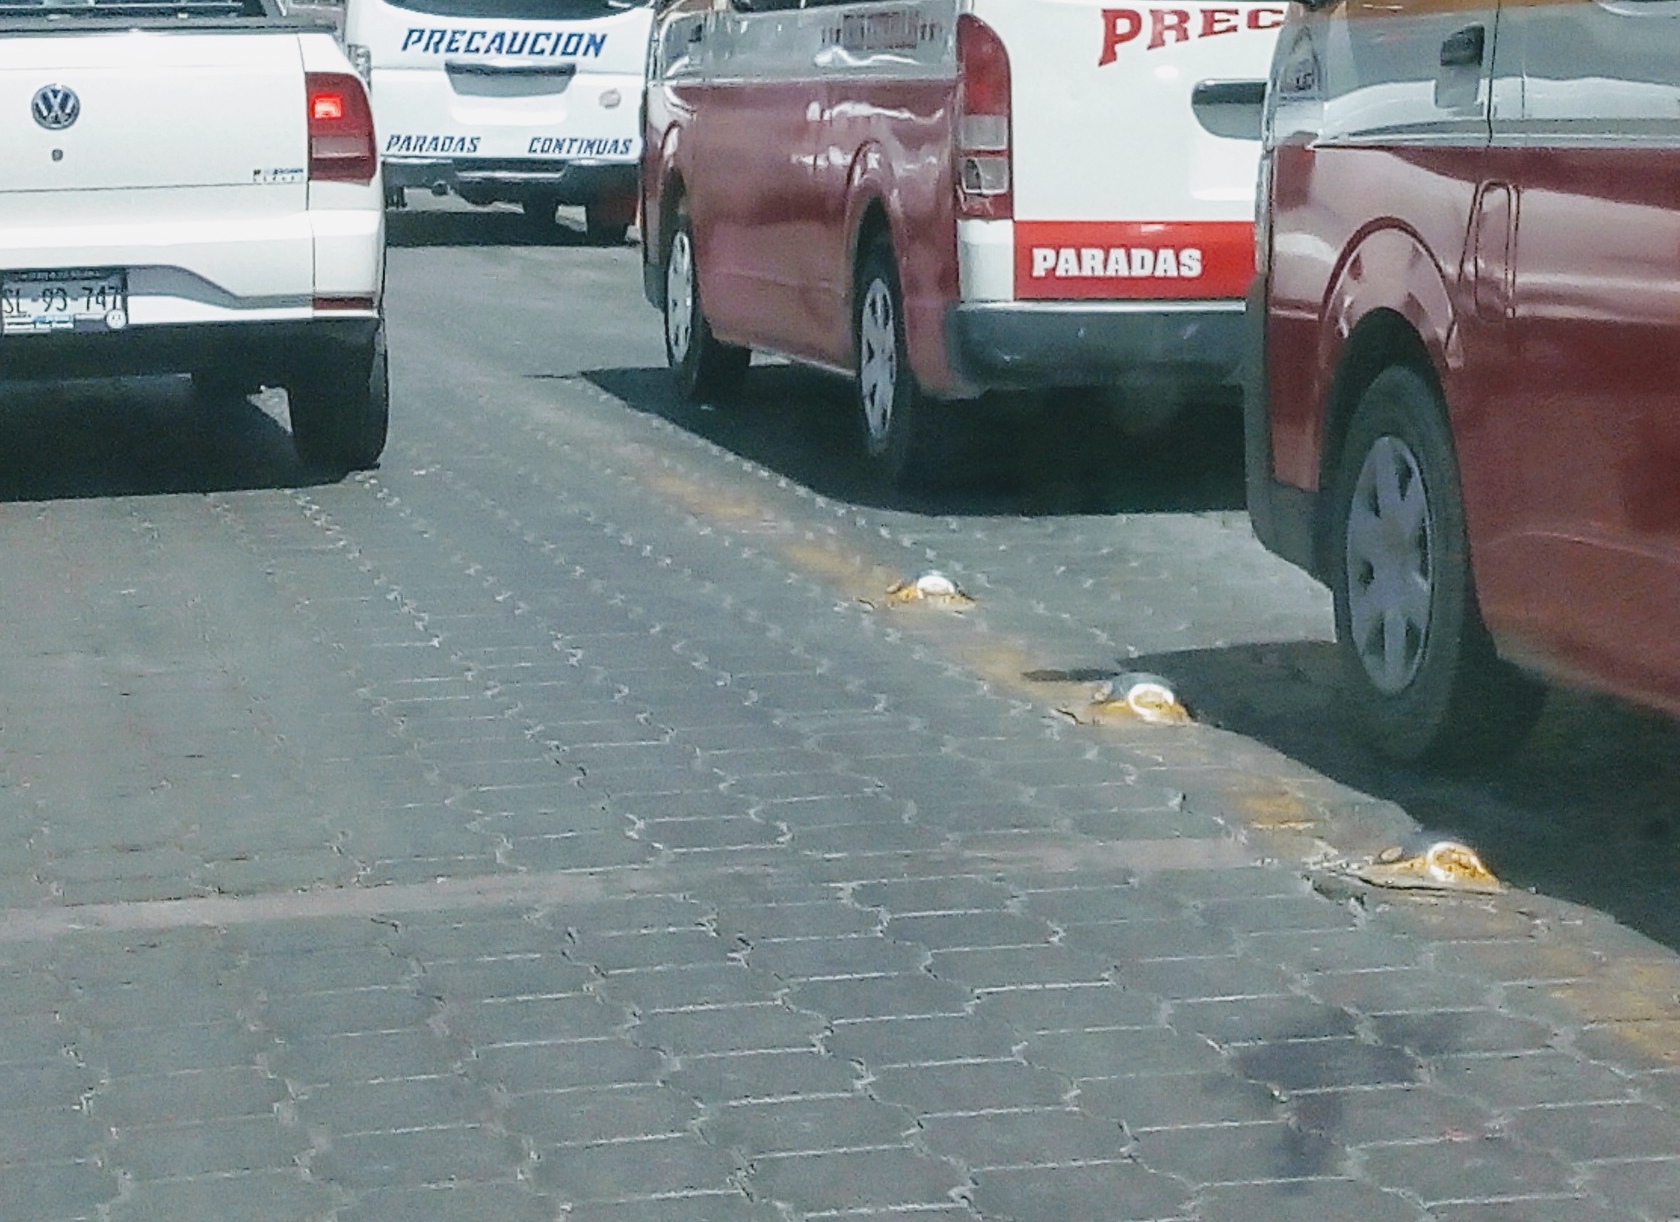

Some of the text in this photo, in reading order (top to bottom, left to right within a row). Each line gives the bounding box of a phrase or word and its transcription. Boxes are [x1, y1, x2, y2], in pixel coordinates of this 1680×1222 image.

[401, 27, 607, 58] PRECAUCION
[386, 133, 633, 156] PARADAS CONTINUAS
[1031, 246, 1203, 279] PARADAS
